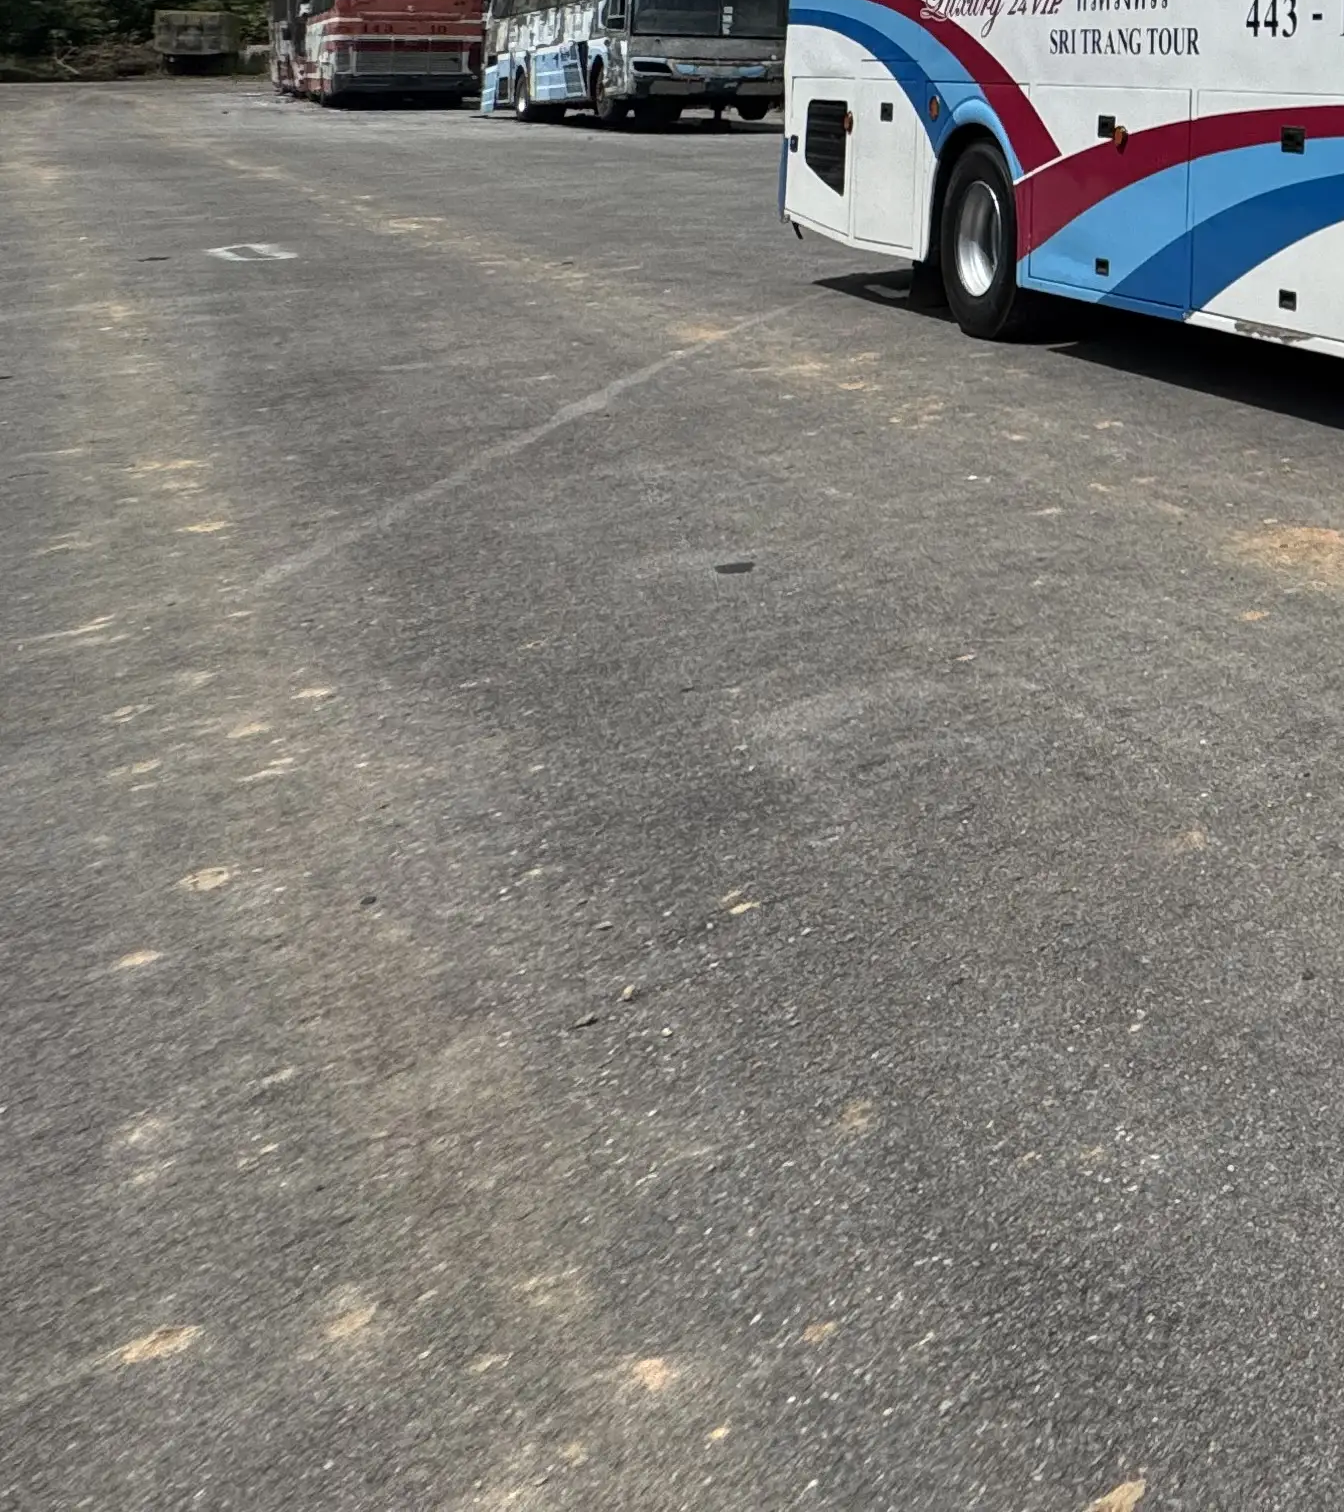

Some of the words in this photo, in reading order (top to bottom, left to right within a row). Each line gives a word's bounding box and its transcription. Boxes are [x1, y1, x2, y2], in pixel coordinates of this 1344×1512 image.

[1049, 28, 1077, 55] SRI
[1080, 28, 1142, 55] TRANG
[1146, 28, 1200, 55] TOUR
